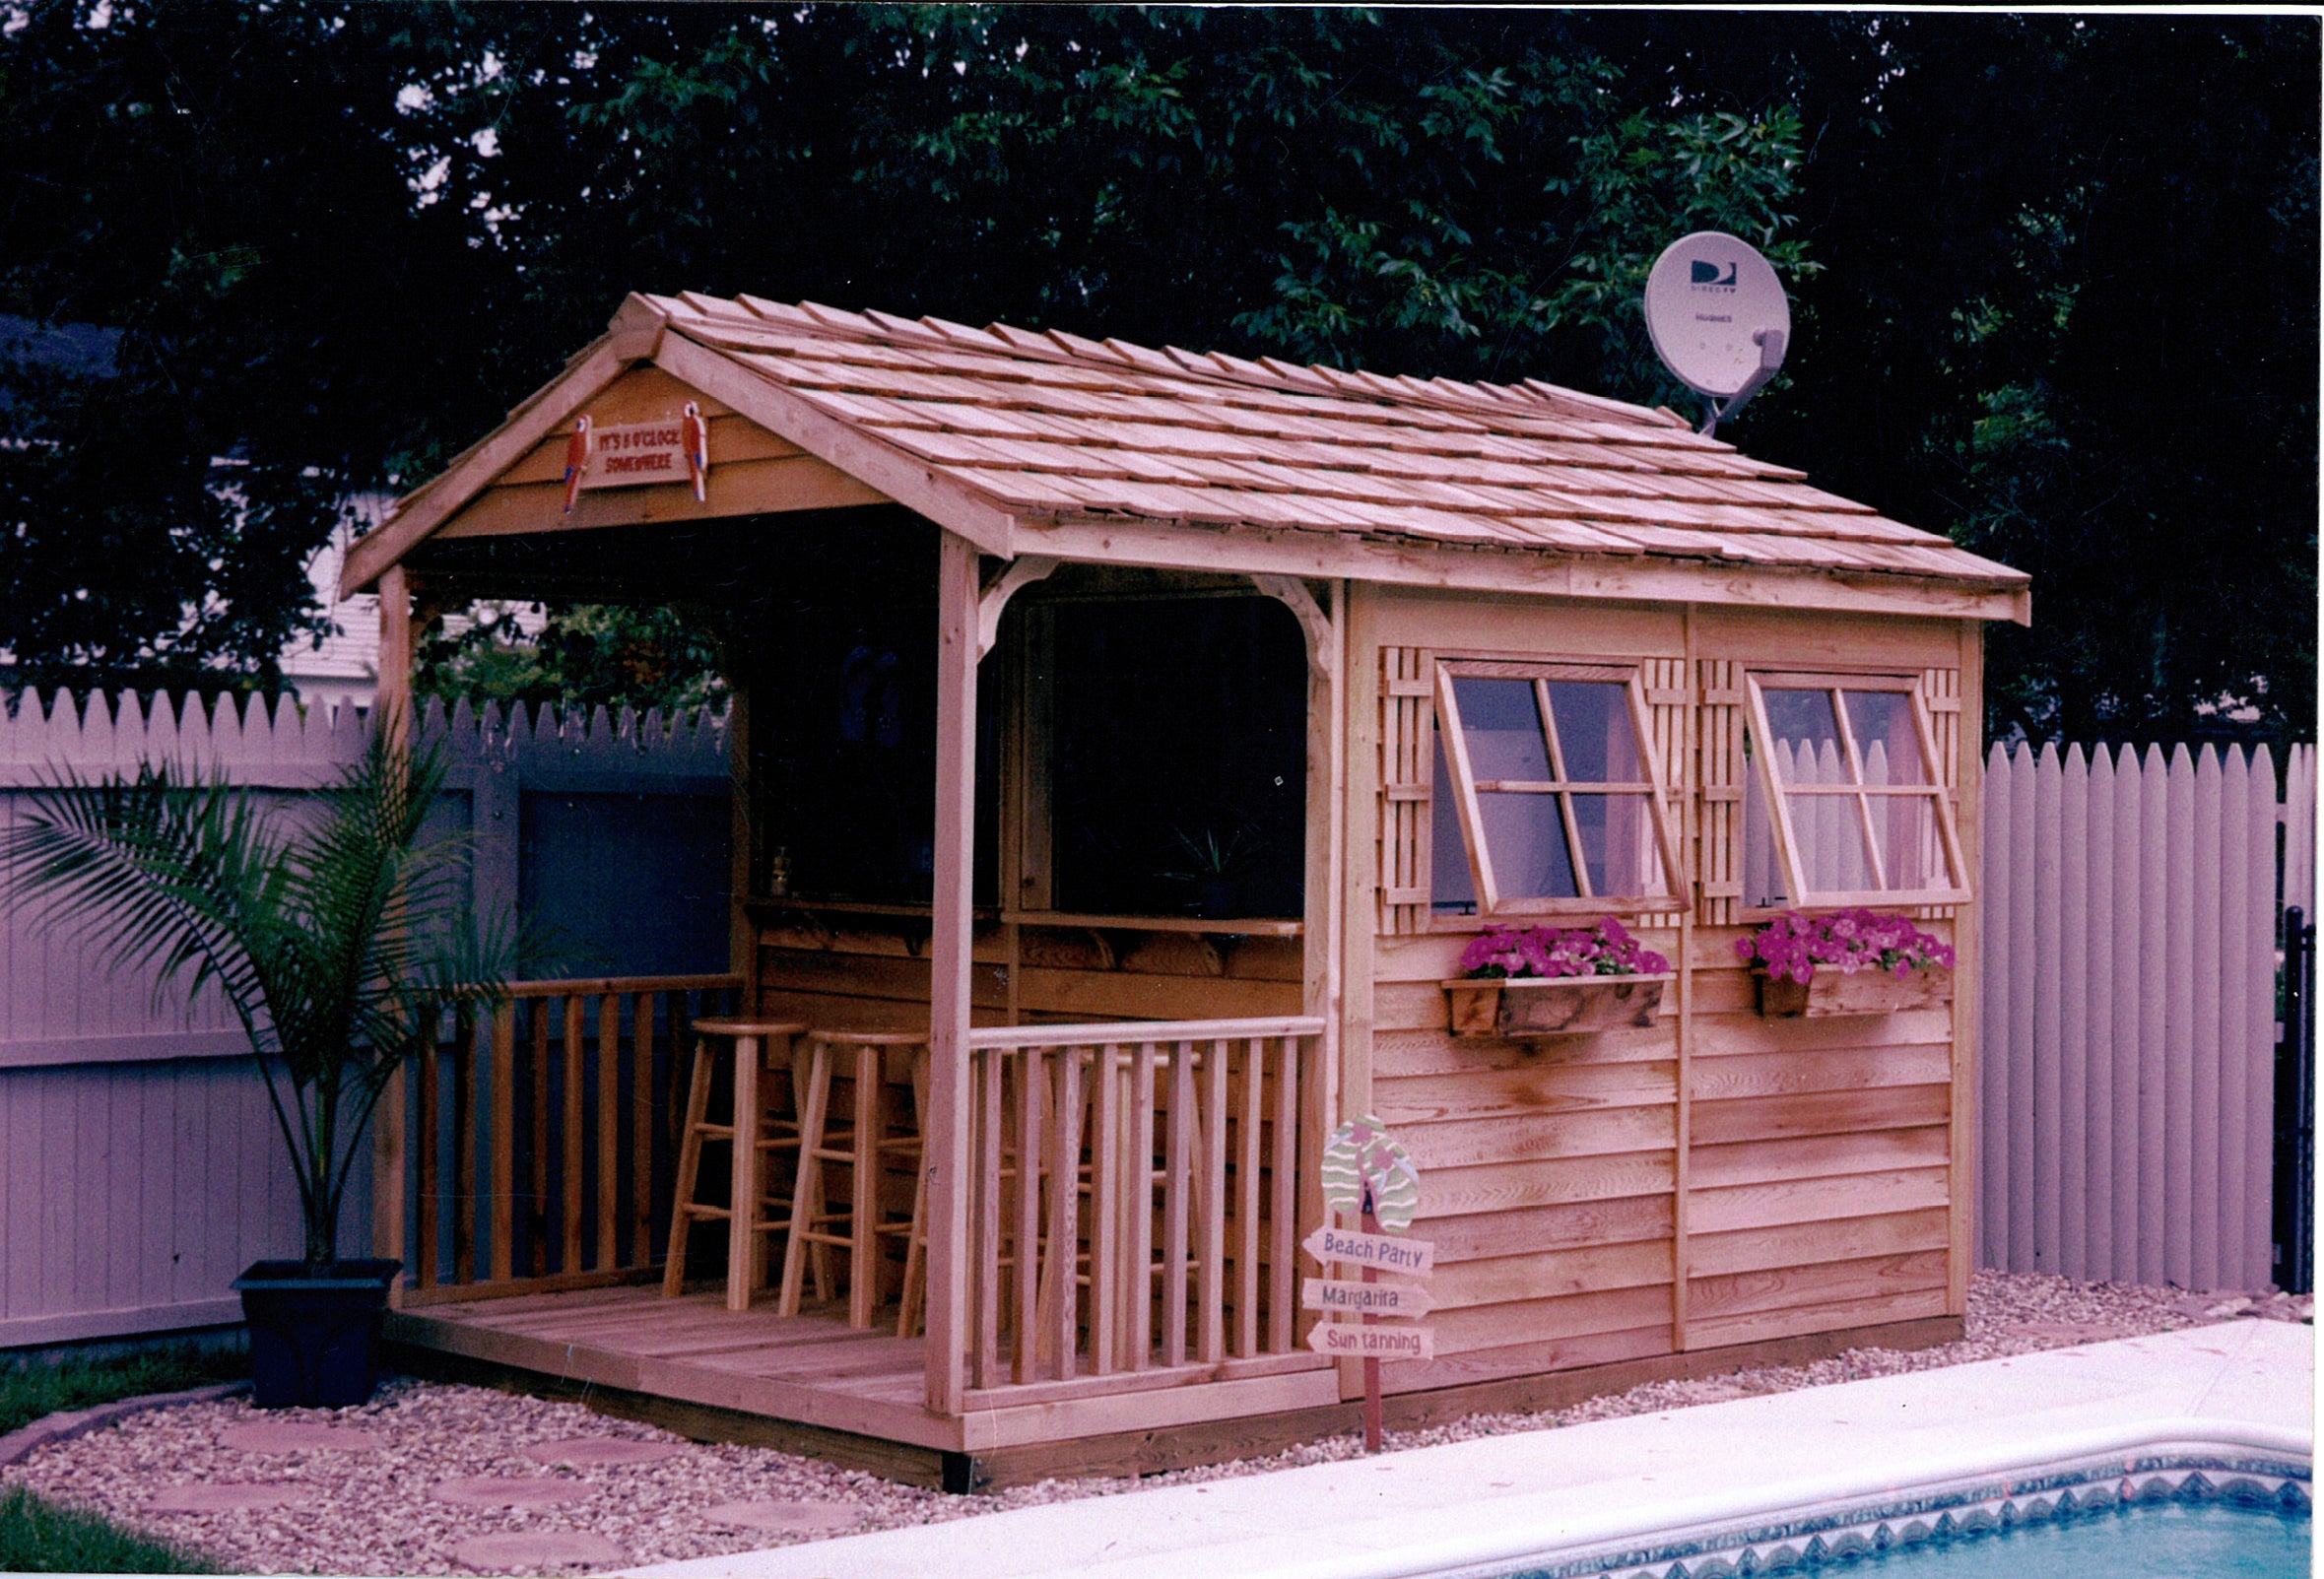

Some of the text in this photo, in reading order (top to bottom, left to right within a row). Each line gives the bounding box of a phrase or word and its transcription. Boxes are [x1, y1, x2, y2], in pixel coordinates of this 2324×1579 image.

[605, 452, 672, 474] SOMEWHERE
[1324, 1232, 1424, 1268] Beach Party
[1322, 1285, 1399, 1310] Margarita
[1326, 1329, 1422, 1356] Sun tanning
